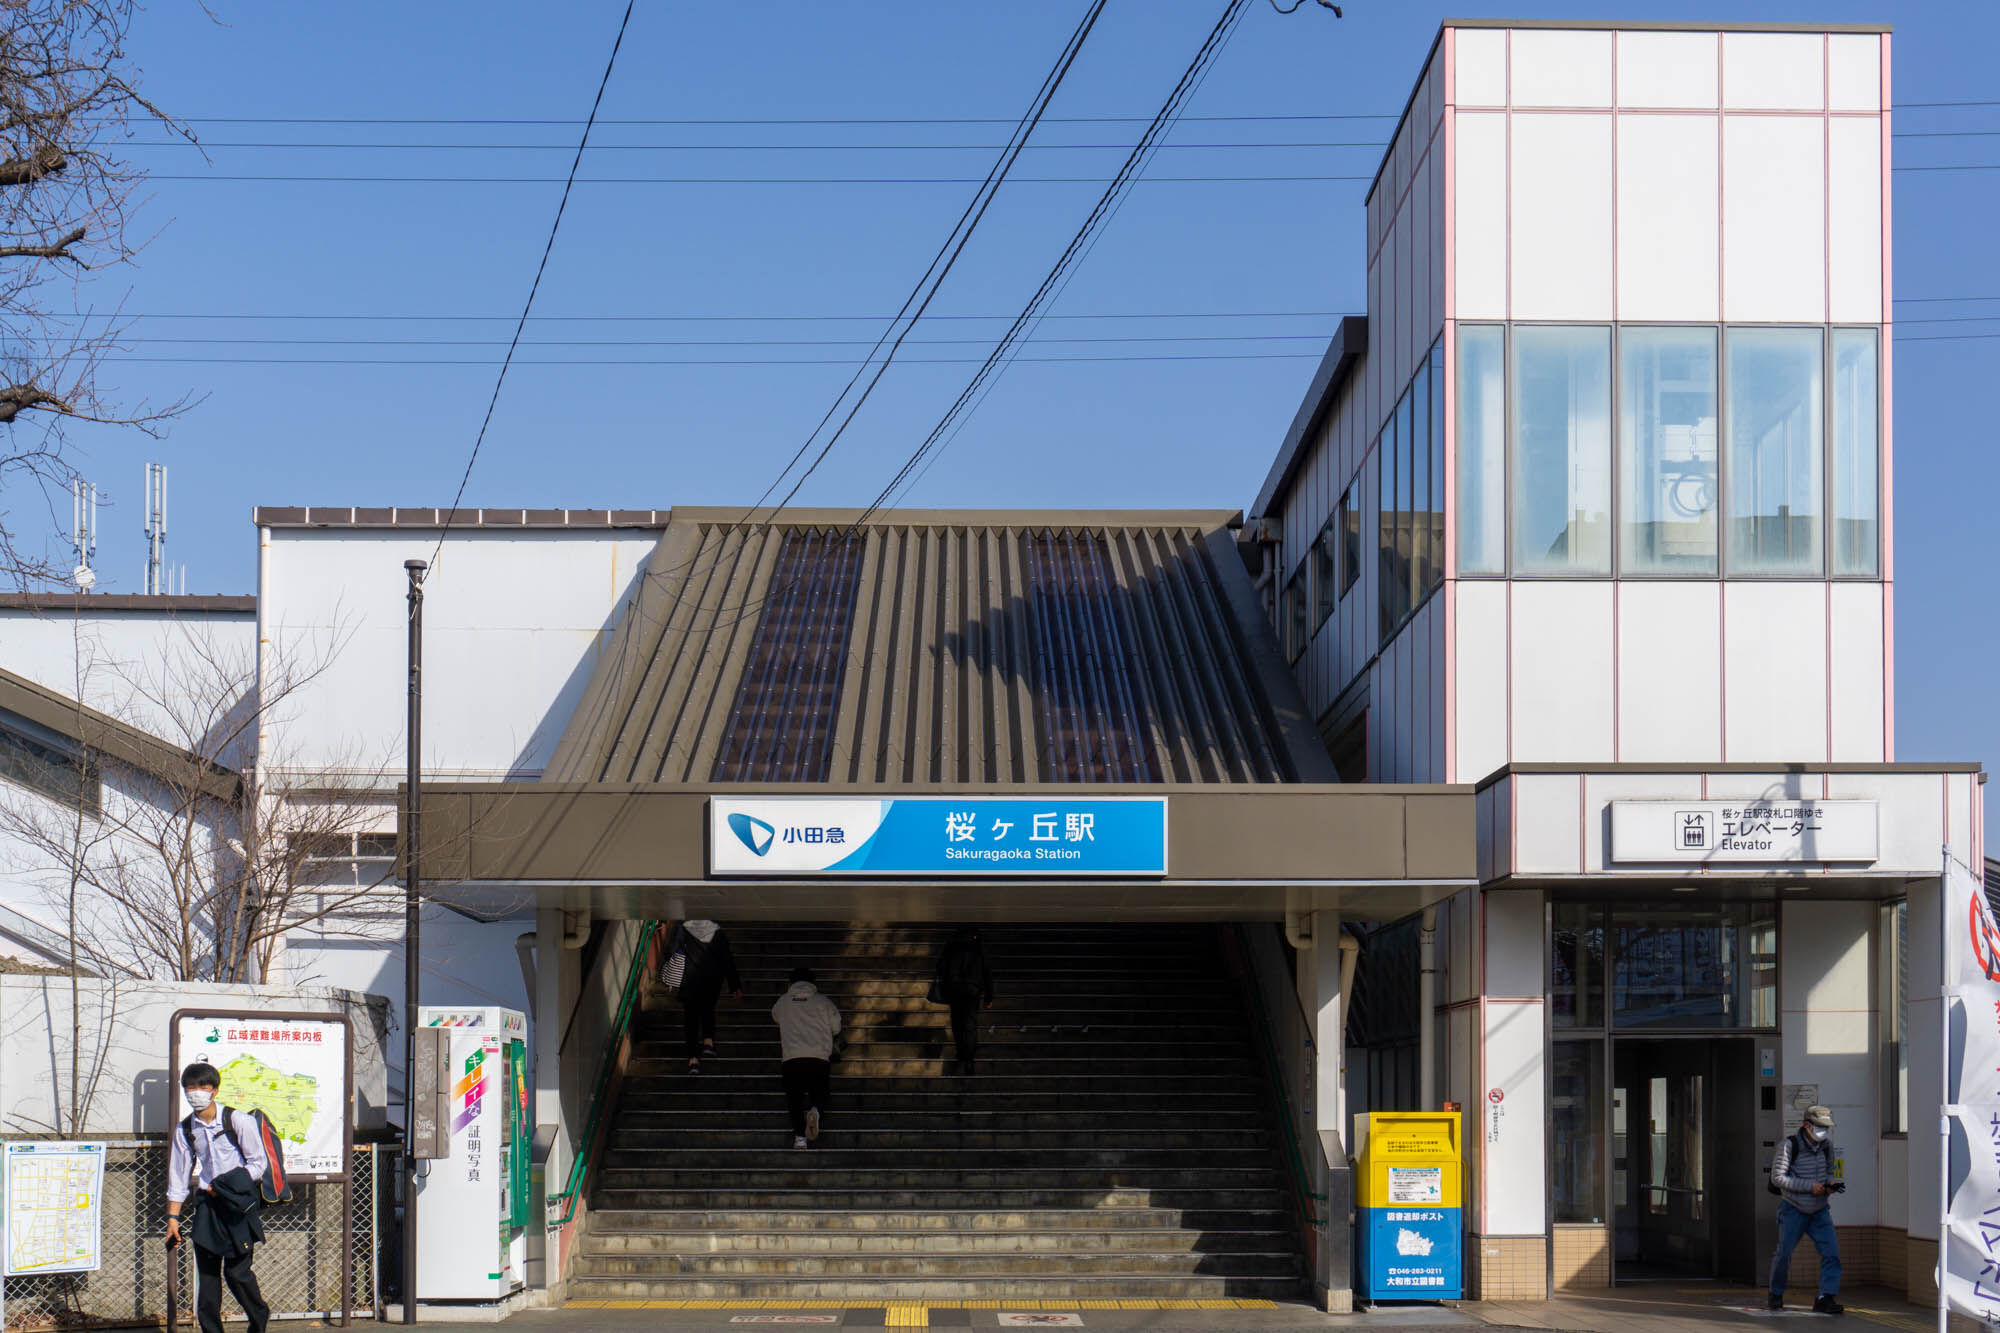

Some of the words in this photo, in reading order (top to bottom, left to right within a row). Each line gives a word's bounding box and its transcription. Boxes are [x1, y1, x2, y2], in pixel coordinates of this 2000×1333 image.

[1721, 808, 1824, 819] 桜ヶ丘駅改札口階ゆき
[945, 811, 1095, 843] 桜ヶ丘駅
[1721, 821, 1822, 837] エレベーター
[782, 826, 846, 844] 小田急
[1721, 838, 1772, 850] Elevator
[945, 847, 1032, 861] Sakuragaoka
[1035, 847, 1081, 860] Station
[227, 1029, 323, 1042] 広域避難場所案内板
[468, 1055, 481, 1117] キレイな
[467, 1125, 481, 1182] 証明写真
[1386, 1276, 1445, 1286] 大和市立図書館
